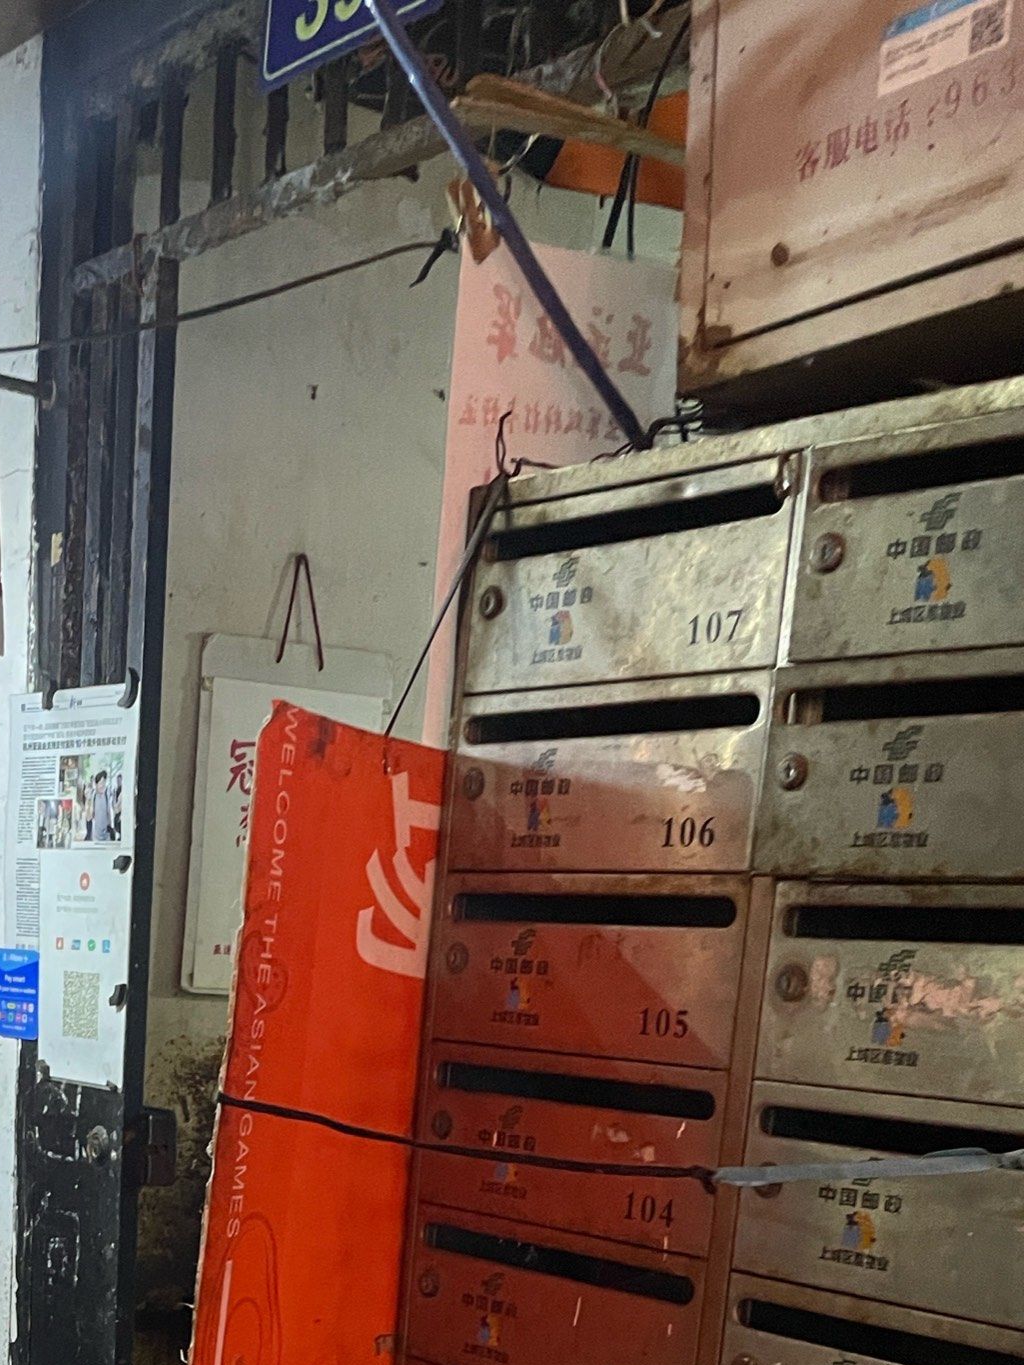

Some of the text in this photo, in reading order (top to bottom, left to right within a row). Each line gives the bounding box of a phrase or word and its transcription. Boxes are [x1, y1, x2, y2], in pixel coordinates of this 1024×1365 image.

[688, 609, 744, 646] 107
[662, 817, 716, 848] 106
[227, 706, 300, 1240] WELCOME THE ASIAN GAMES
[639, 1008, 690, 1039] 105
[623, 1192, 675, 1228] 104
[818, 1183, 903, 1214] 中国邮政
